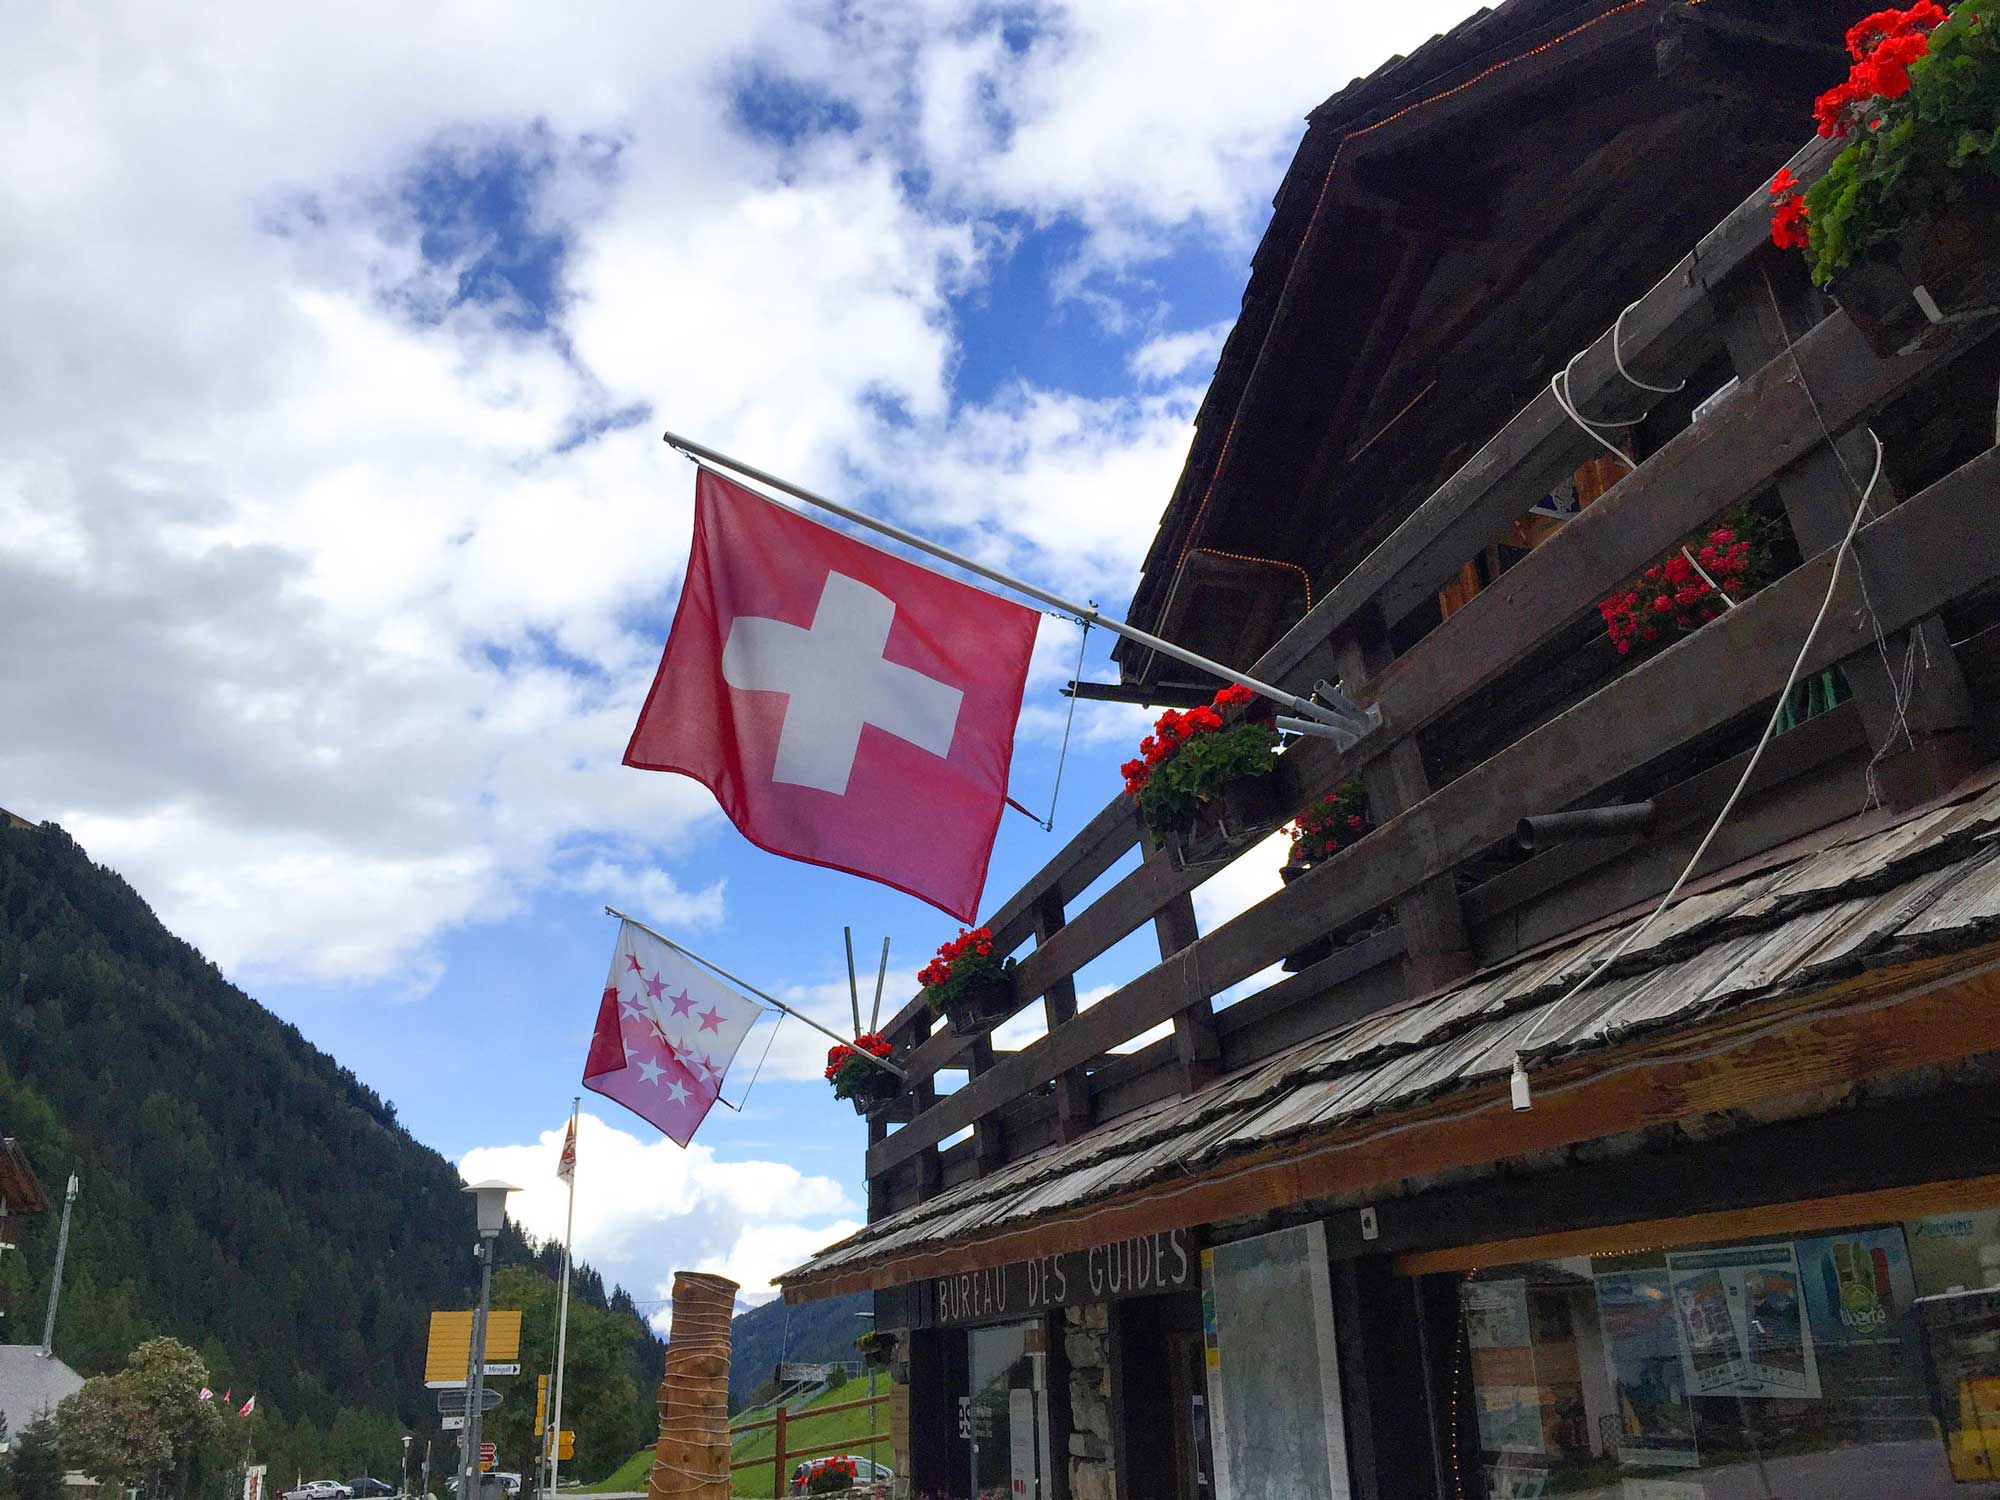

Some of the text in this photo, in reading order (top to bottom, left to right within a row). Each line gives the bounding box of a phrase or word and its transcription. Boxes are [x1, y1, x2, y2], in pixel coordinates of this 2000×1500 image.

[938, 1228, 1187, 1322] BUREAU DES GUIDES
